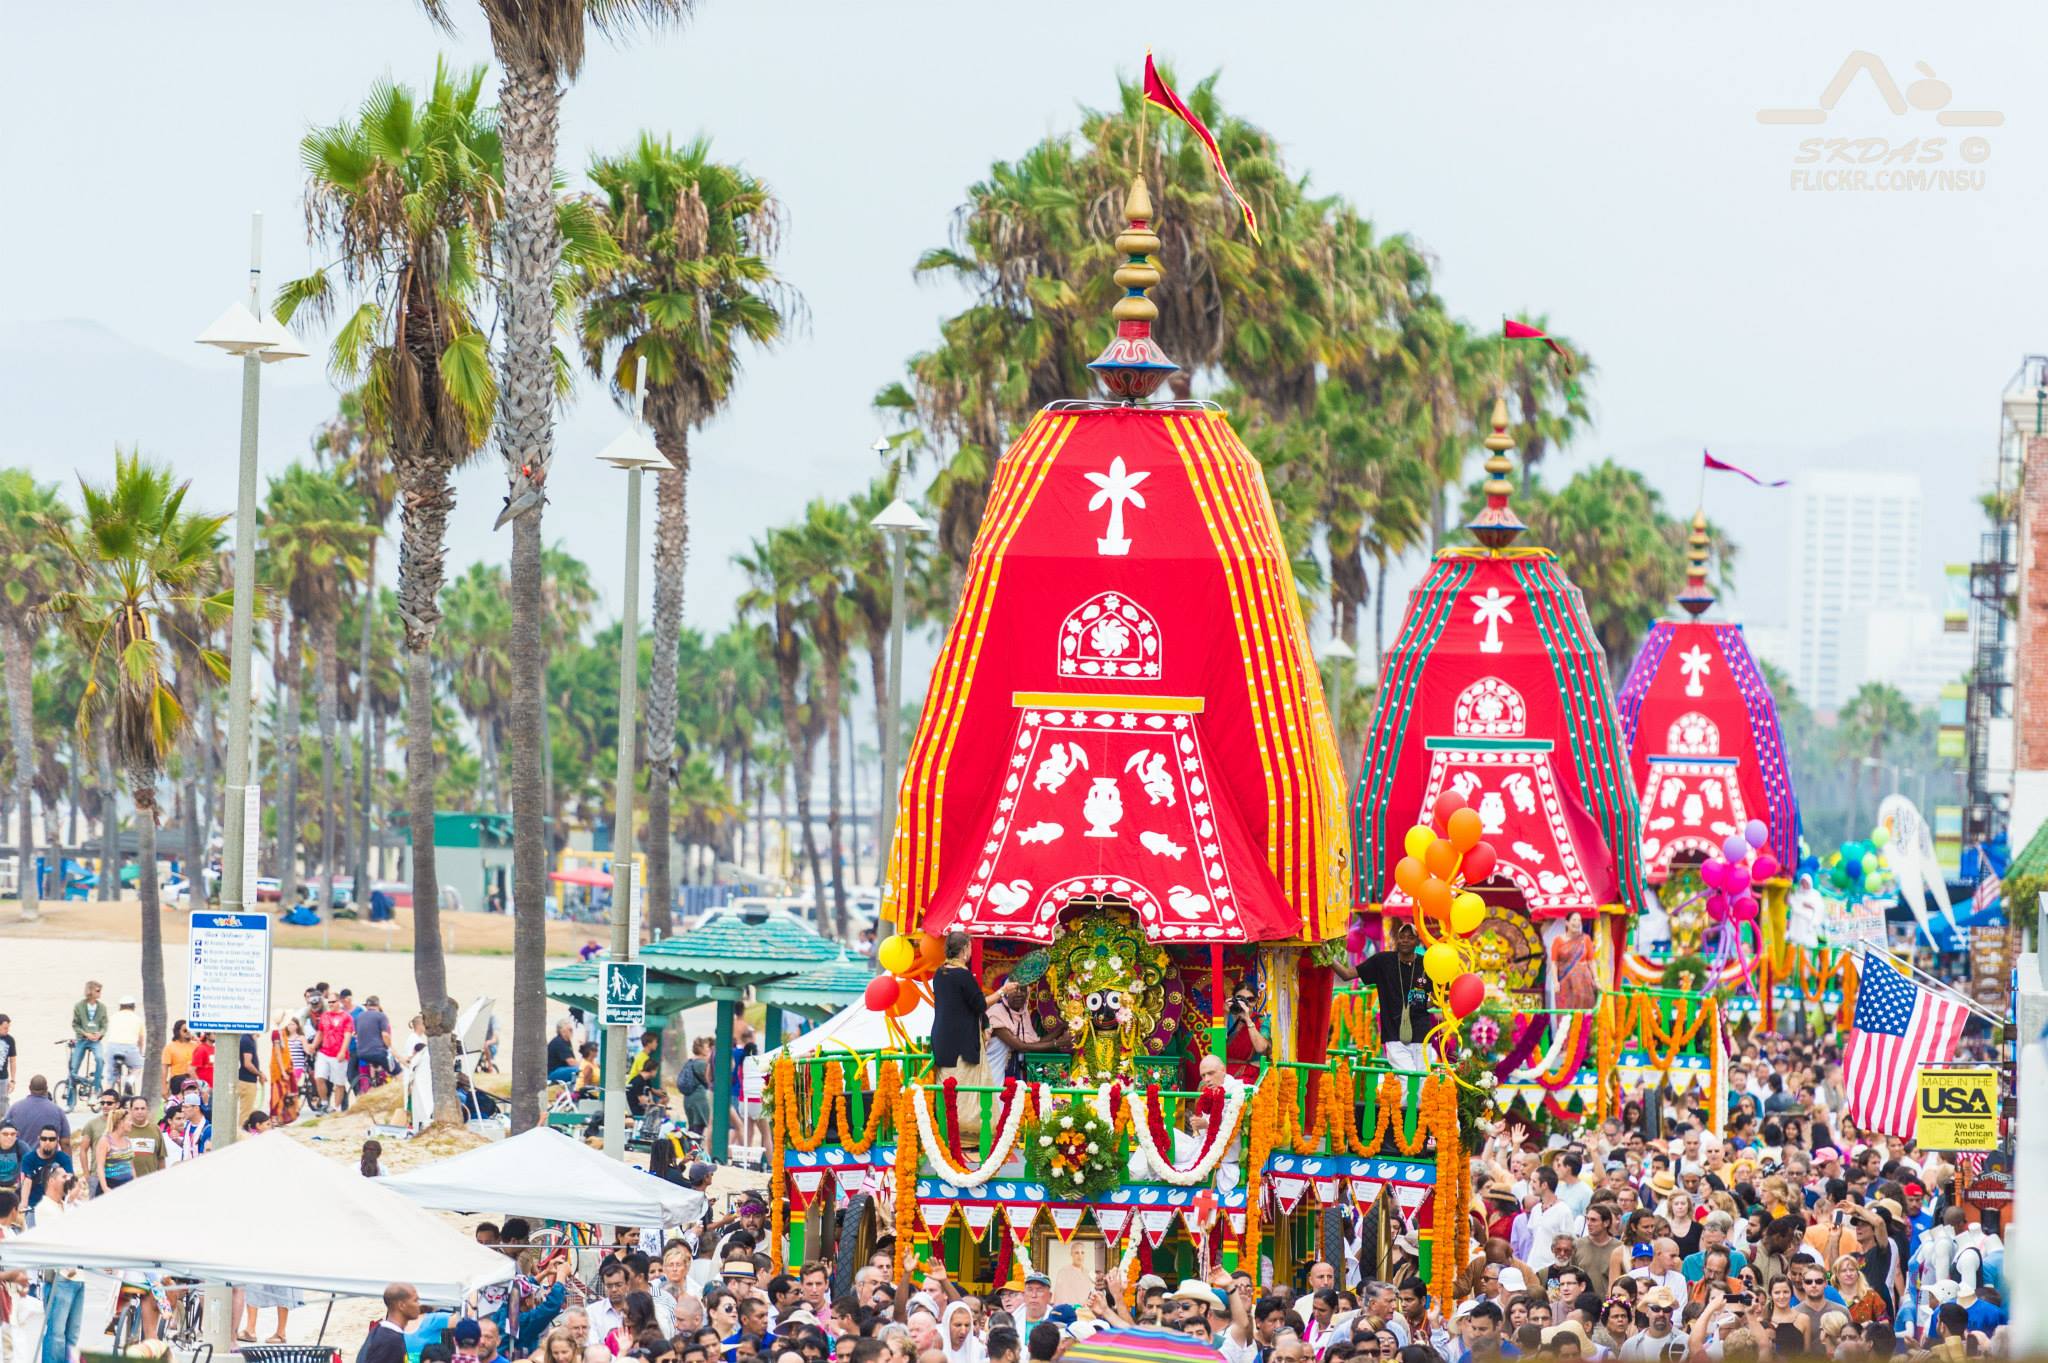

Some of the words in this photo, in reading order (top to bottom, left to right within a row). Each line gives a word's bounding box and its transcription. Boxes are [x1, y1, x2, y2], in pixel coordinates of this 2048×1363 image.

[1922, 1078, 1954, 1087] MADE
[1957, 1078, 1968, 1087] IN
[1972, 1078, 1992, 1087] THE
[1922, 1088, 1992, 1113] USA
[1954, 1137, 1986, 1145] Apparel
